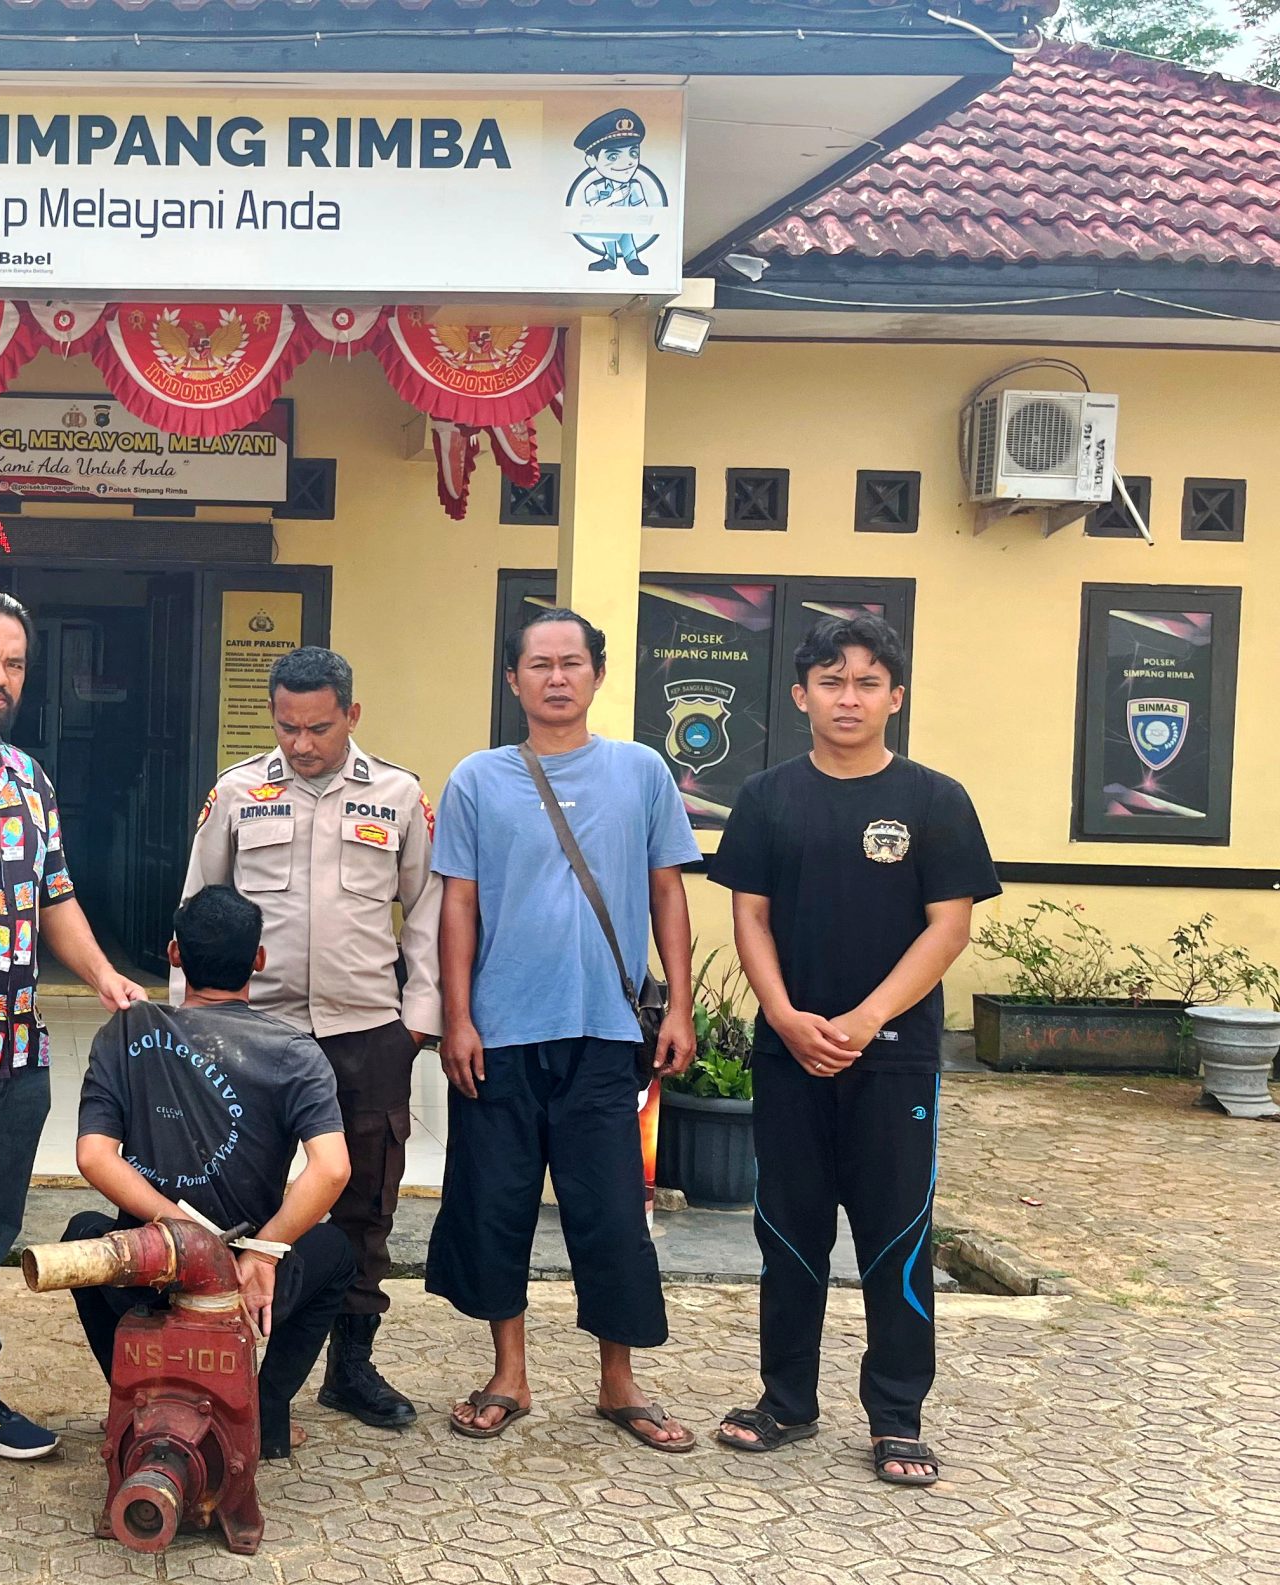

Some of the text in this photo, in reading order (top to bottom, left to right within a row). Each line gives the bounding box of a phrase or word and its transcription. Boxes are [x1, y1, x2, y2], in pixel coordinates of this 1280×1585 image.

[287, 117, 512, 169] RIMBA
[40, 188, 224, 239] Melayani
[236, 189, 341, 231] Anda
[144, 362, 256, 401] INDONESIA
[427, 354, 538, 392] INDONESIA
[29, 430, 164, 455] MENGAYOMI,
[169, 433, 277, 455] MELAYANI
[38, 457, 72, 474] Ada
[76, 457, 127, 476] Untuk
[132, 459, 176, 476] Anda
[108, 486, 132, 494] Polsek
[133, 486, 164, 495] Simpang
[680, 633, 723, 644] POLSEK
[653, 648, 749, 661] SIMPANG RIMBA
[1143, 658, 1176, 666] POLSEK
[1123, 669, 1195, 679] SIMPANG RIMBA
[1138, 703, 1178, 713] BINMAS
[345, 801, 397, 822] POLRI
[204, 1157, 220, 1177] Of
[215, 1129, 239, 1161] View
[124, 1342, 236, 1375] NS-100
